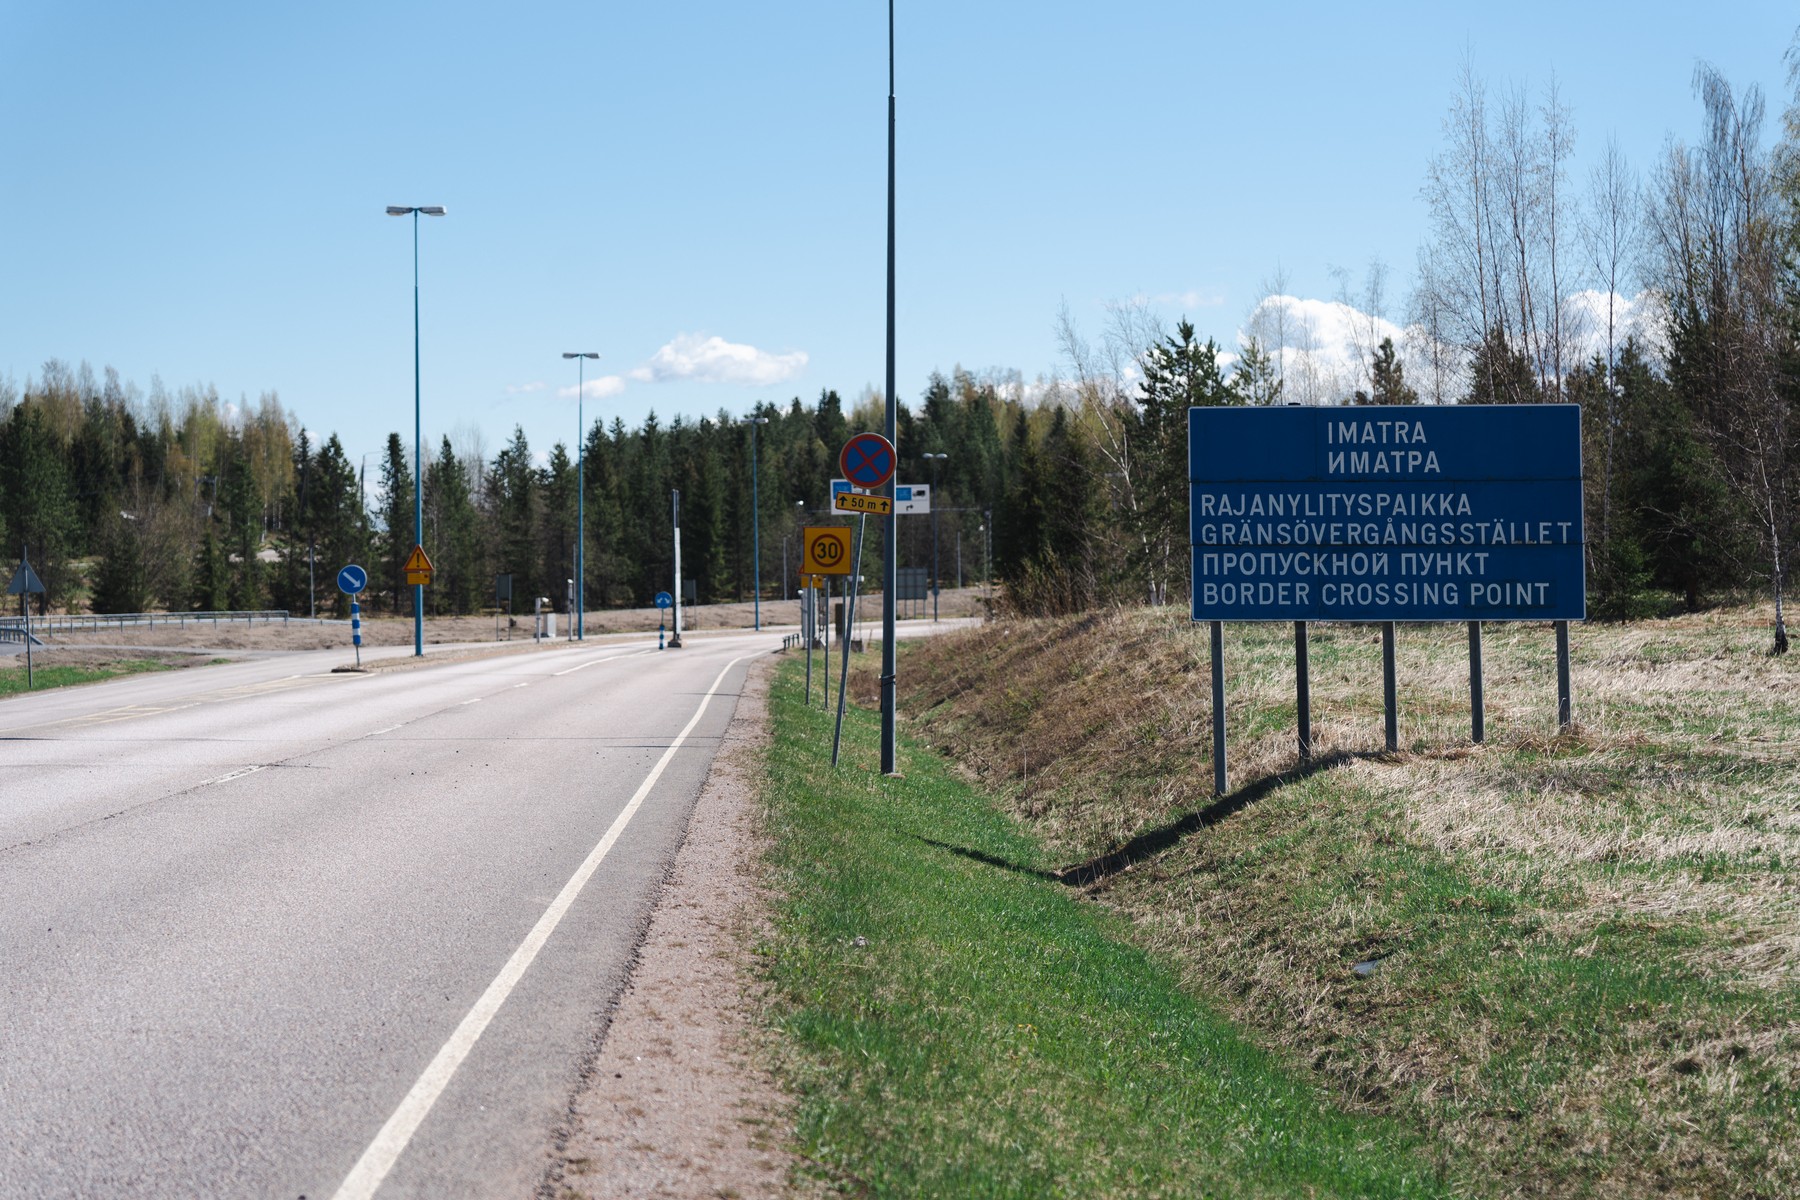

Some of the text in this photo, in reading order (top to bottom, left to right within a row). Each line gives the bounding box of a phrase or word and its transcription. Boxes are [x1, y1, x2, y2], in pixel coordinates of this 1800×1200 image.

[1328, 421, 1427, 444] IMATRA
[1328, 451, 1441, 474] ИМАТРА
[851, 498, 876, 509] 50 m
[1201, 493, 1472, 516] RAJANYLITYSPAIKKA
[1202, 518, 1572, 545] GRÄNSÖVERGÅNGSSTÄLLET
[817, 542, 838, 559] 30
[1203, 552, 1489, 576] ПРОПУСКНОЙ ПУНКТ
[1204, 582, 1550, 605] BORDER CROSSING POINT
